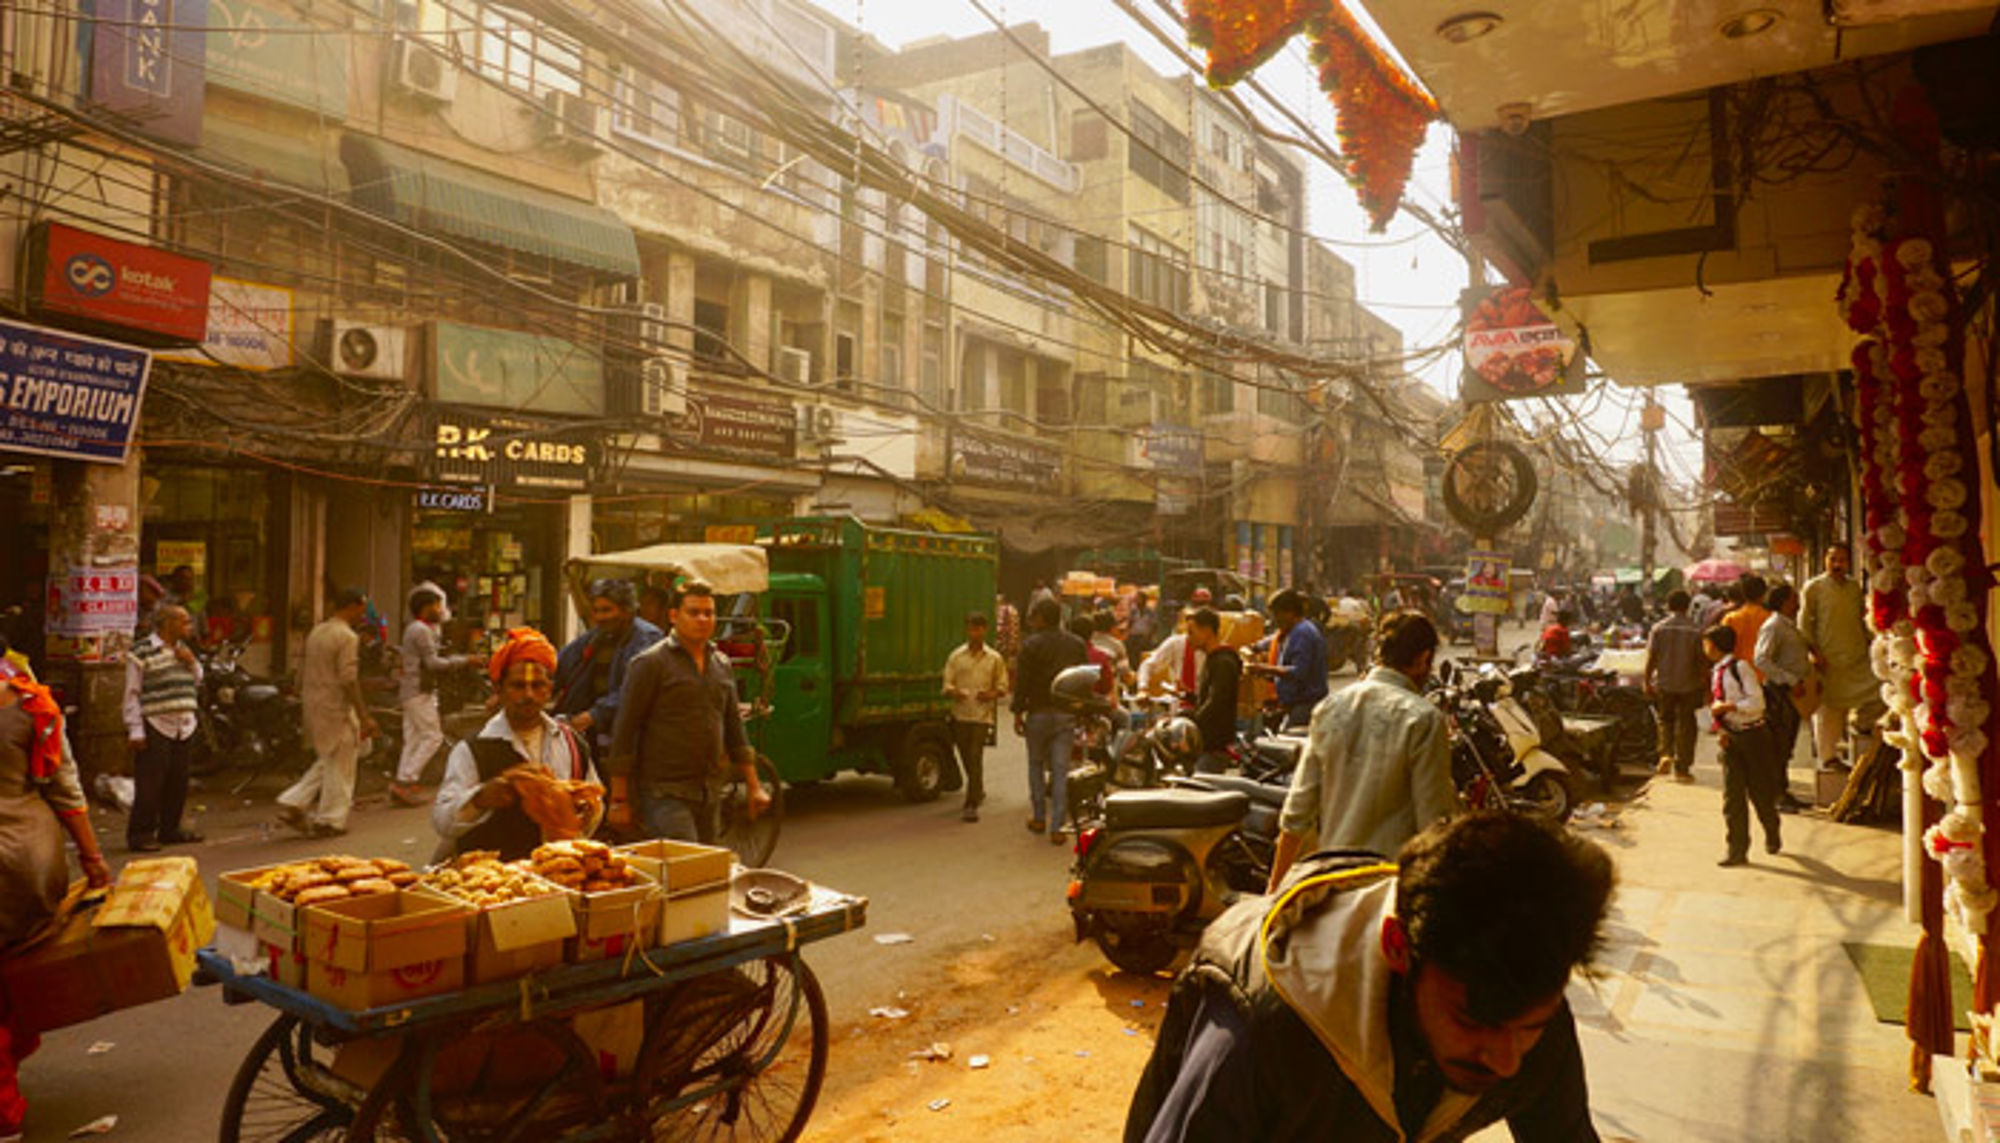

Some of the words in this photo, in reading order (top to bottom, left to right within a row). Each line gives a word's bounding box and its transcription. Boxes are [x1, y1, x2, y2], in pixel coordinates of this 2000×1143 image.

[120, 266, 175, 292] kotak
[9, 375, 135, 425] EMPORIUM
[505, 440, 587, 465] CARDS
